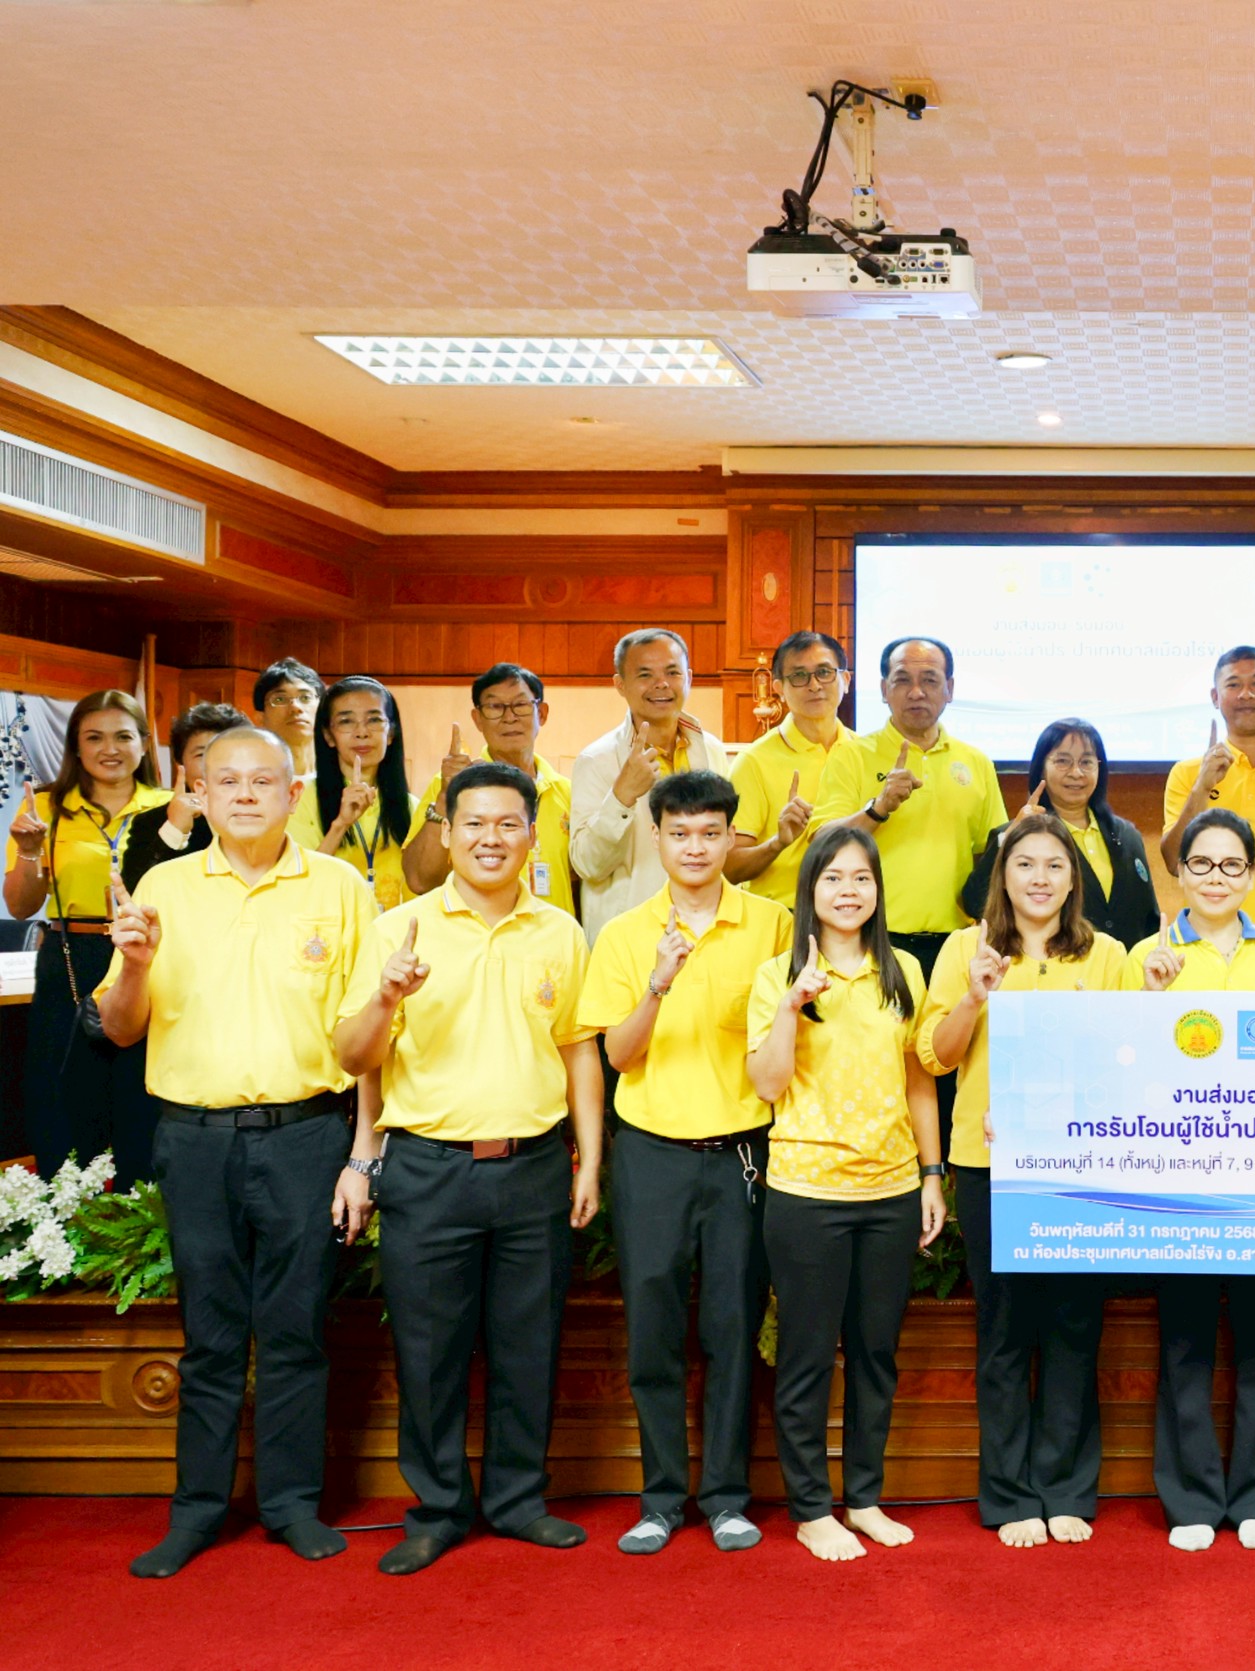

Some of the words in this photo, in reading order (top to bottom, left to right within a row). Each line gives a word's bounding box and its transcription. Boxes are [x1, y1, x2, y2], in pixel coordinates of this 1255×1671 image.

[1015, 1151, 1092, 1174] บริเวณหมู่ที่
[1098, 1157, 1114, 1169] 14
[1119, 1150, 1165, 1175] (ทั้งหมู่)
[1169, 1151, 1222, 1175] และหมู่ที่
[1244, 1158, 1253, 1171] 9
[1030, 1217, 1124, 1240] วันพฤหัสบดีที่
[1128, 1225, 1145, 1238] 31
[1151, 1226, 1220, 1242] กรกฎาคม
[1014, 1248, 1029, 1259] ณ
[1033, 1244, 1222, 1264] ห้องประชุมเทศบาลเมืองไร่ขิง
